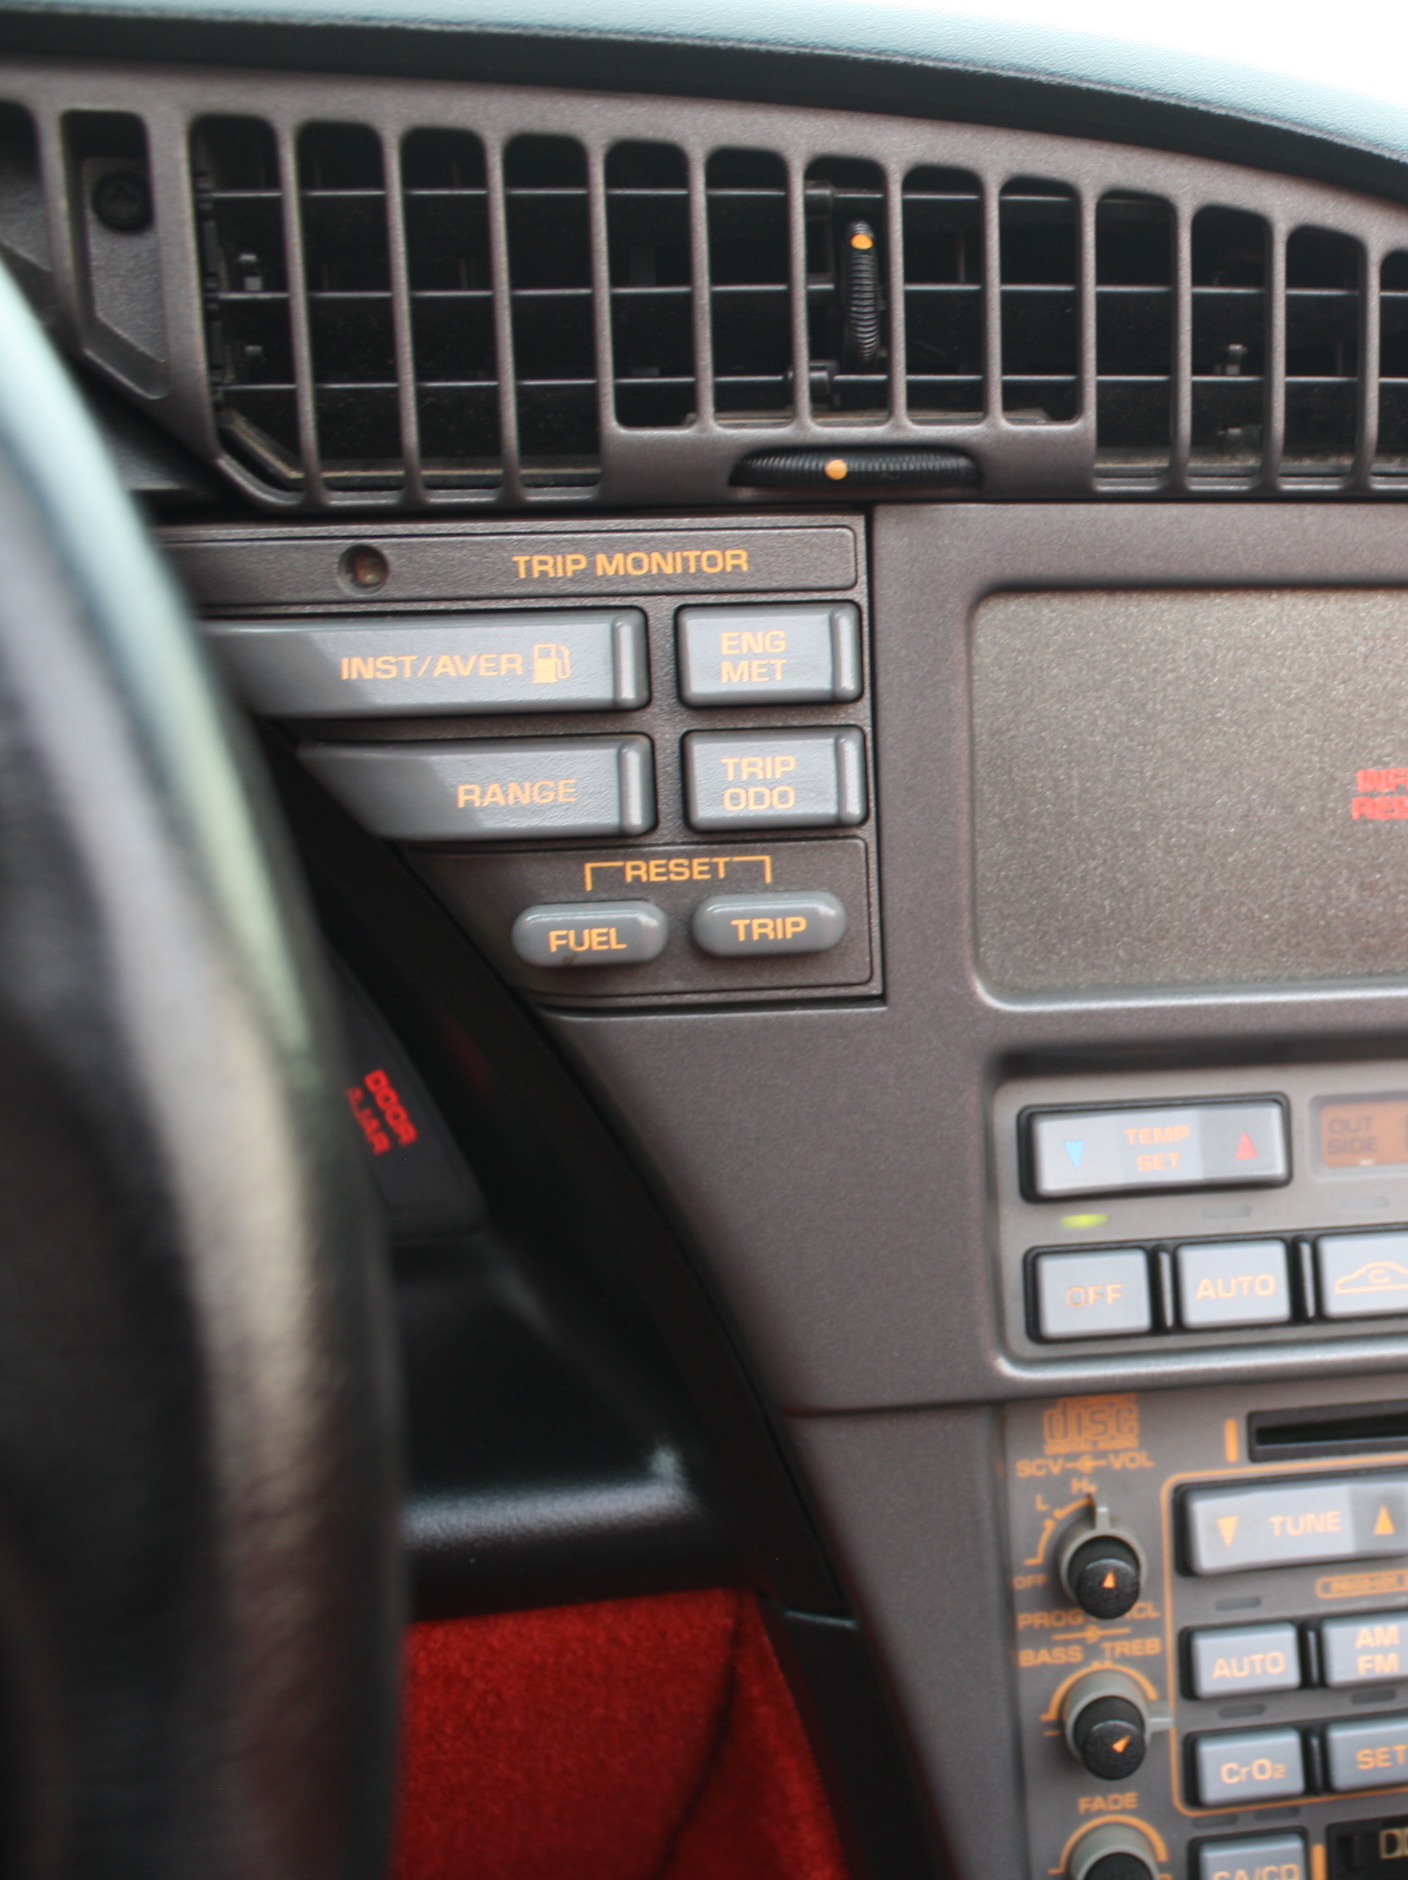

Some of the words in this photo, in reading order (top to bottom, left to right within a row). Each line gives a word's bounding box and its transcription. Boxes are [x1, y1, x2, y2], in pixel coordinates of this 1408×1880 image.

[512, 553, 587, 578] TRIP
[595, 549, 749, 576] MONITOR
[720, 631, 787, 655] ENG
[340, 653, 524, 681] INST/AVER
[719, 657, 787, 683] MET
[722, 756, 796, 781] TRIP
[457, 779, 579, 808] RANGE
[723, 786, 796, 812] ODO
[624, 857, 729, 882] RESET
[548, 927, 626, 954] FUEL
[732, 916, 807, 942] TRIP
[1125, 1125, 1191, 1146] TEMP
[1327, 1116, 1374, 1135] OUT
[1327, 1136, 1378, 1155] SIDE
[1136, 1153, 1182, 1172] SET
[1066, 1283, 1125, 1309] OFF
[1196, 1274, 1276, 1302] AUTO
[1015, 1458, 1064, 1477] SCV
[1108, 1451, 1156, 1470] VOL
[1270, 1512, 1342, 1537] TUNE
[1013, 1574, 1047, 1589] OFF
[1018, 1609, 1084, 1629] PROG
[1355, 1626, 1399, 1650] AM
[1019, 1645, 1084, 1667] BASS
[1102, 1637, 1161, 1659] TREB
[1211, 1652, 1286, 1680] AUTO
[1357, 1655, 1399, 1676] FM
[1356, 1743, 1408, 1769] SET
[1079, 1793, 1138, 1813] FADE
